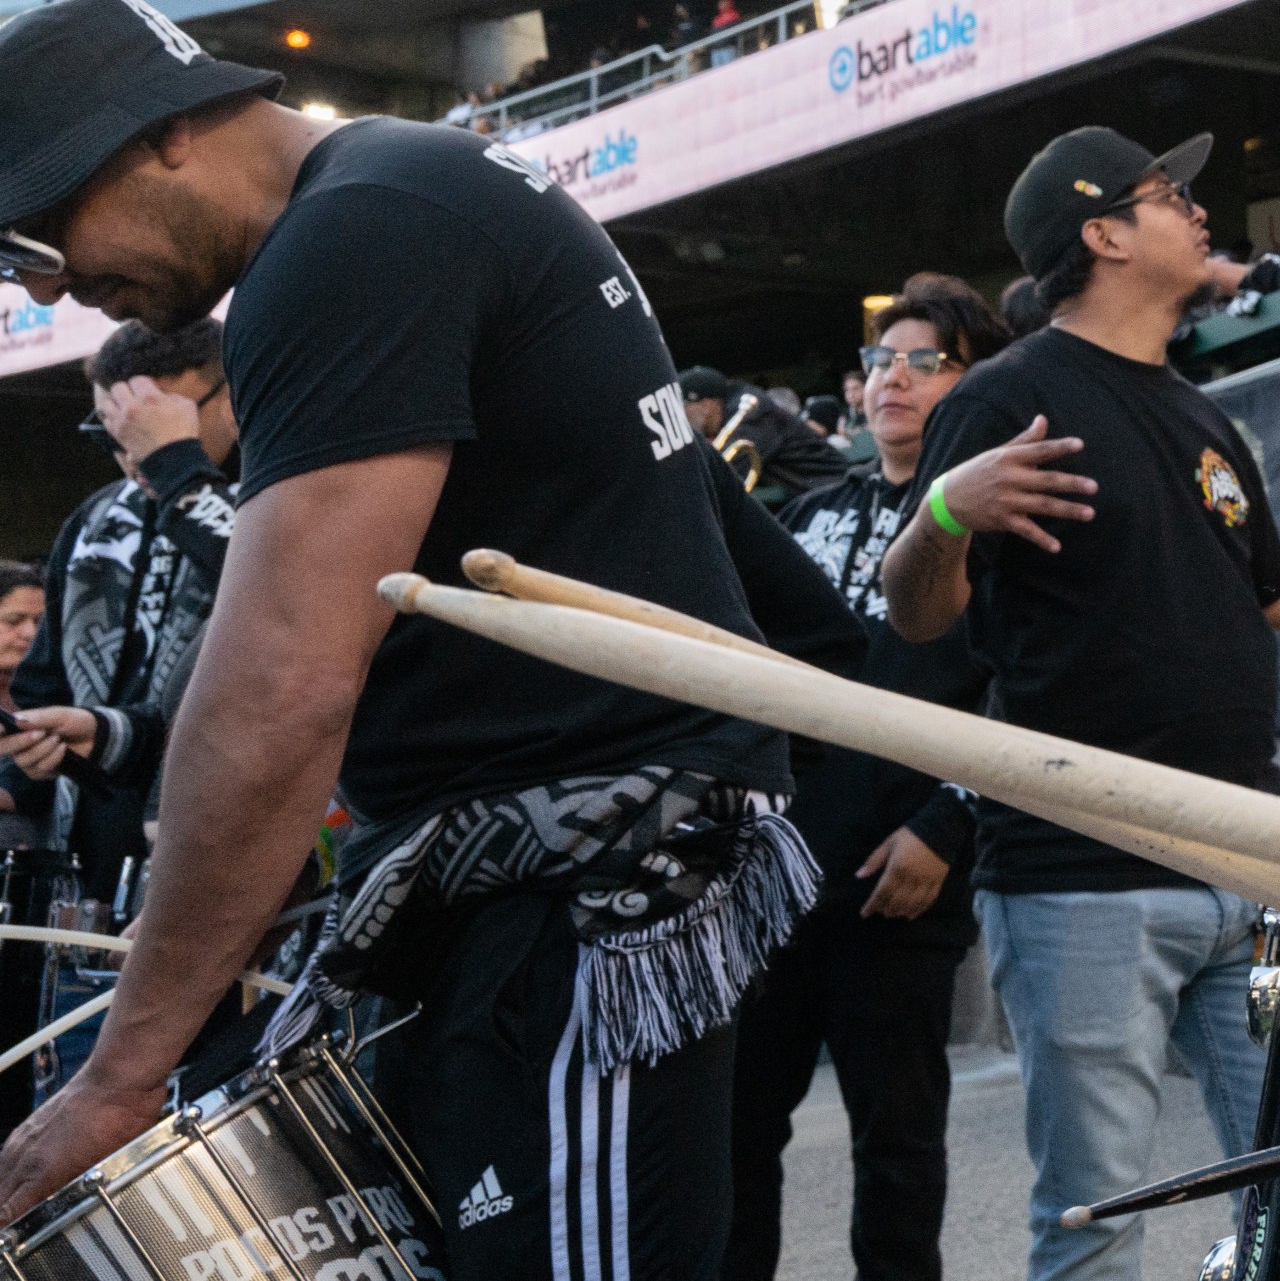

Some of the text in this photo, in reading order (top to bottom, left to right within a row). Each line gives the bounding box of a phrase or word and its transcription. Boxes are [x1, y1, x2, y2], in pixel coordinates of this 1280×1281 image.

[857, 3, 977, 81] bartable
[598, 275, 631, 309] EST.
[458, 1194, 515, 1230] adidas
